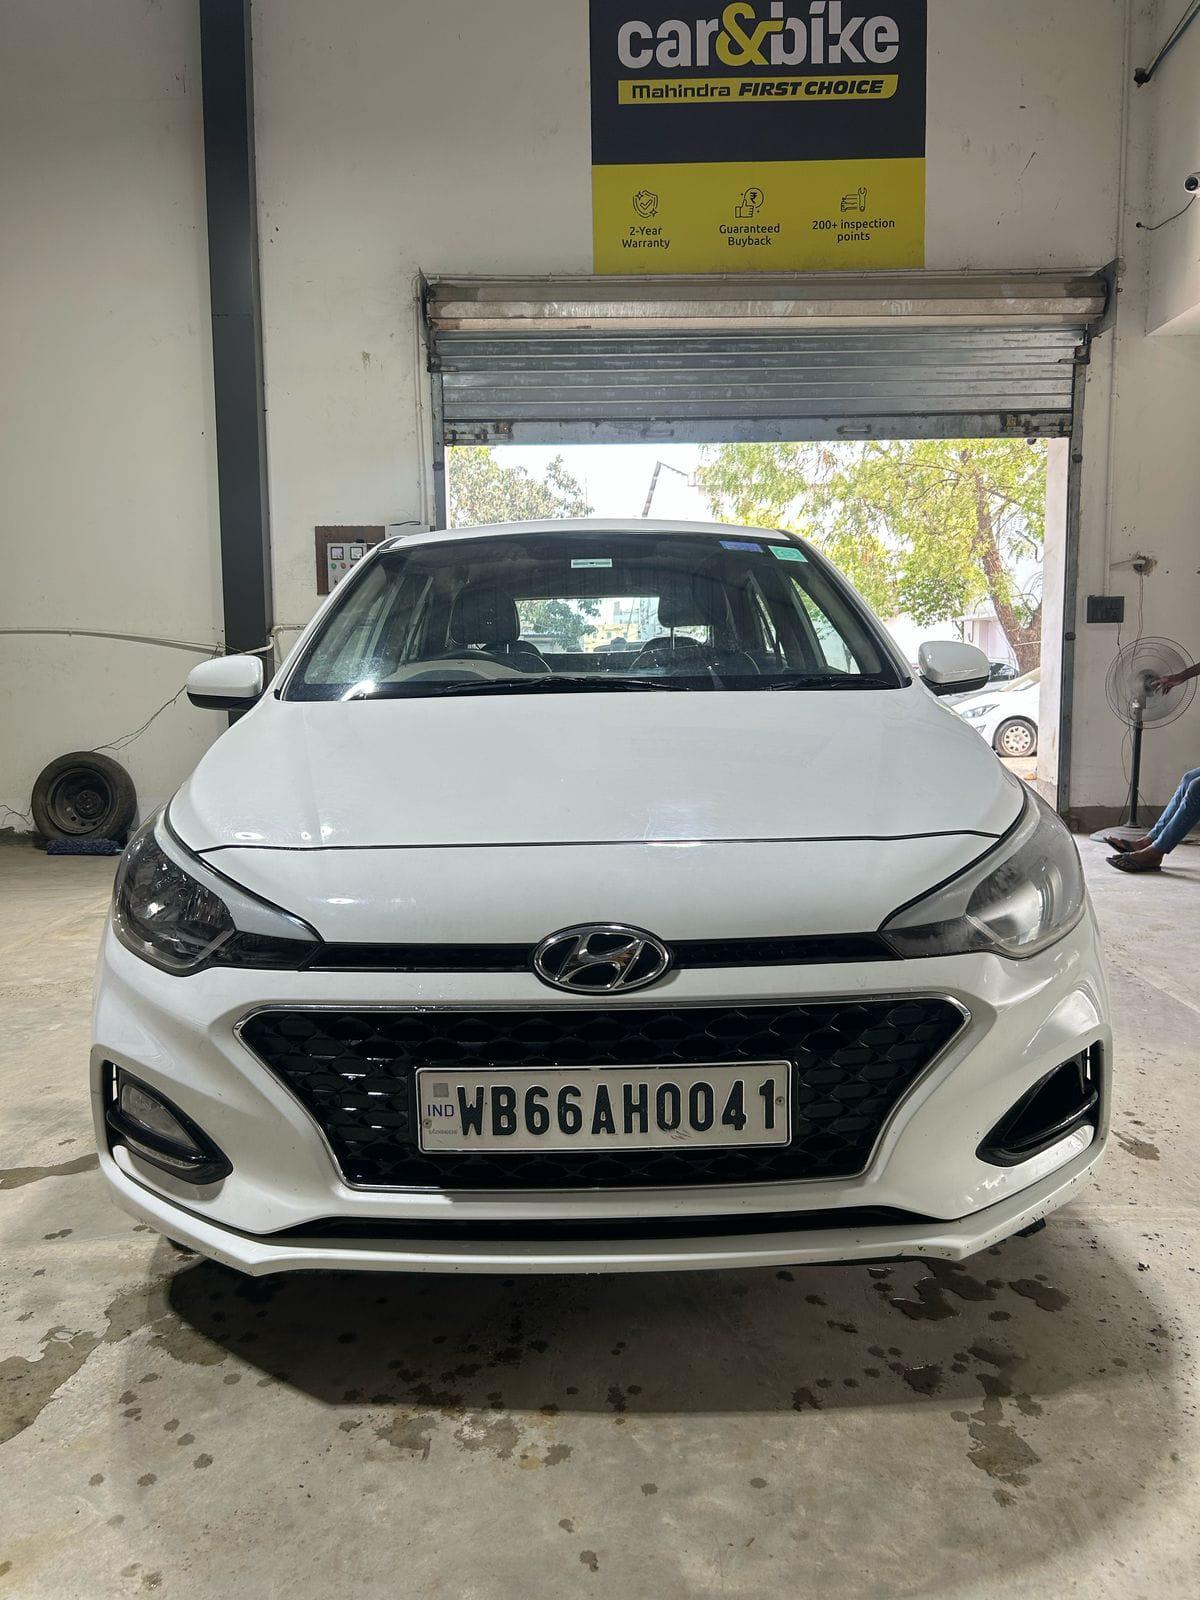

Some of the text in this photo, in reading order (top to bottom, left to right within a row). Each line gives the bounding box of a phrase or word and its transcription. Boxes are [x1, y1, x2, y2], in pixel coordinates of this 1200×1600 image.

[617, 1, 900, 69] car&bike
[632, 79, 884, 99] Mahindra FIRST CHOICE
[629, 226, 663, 236] 2-Year
[719, 223, 781, 235] Guaranteed
[812, 218, 895, 232] 200+ inspection
[728, 236, 772, 248] Buyback
[837, 231, 871, 243] points
[622, 238, 671, 250] Warranty
[427, 1104, 455, 1117] IND
[456, 1078, 776, 1137] WB66AH0041
